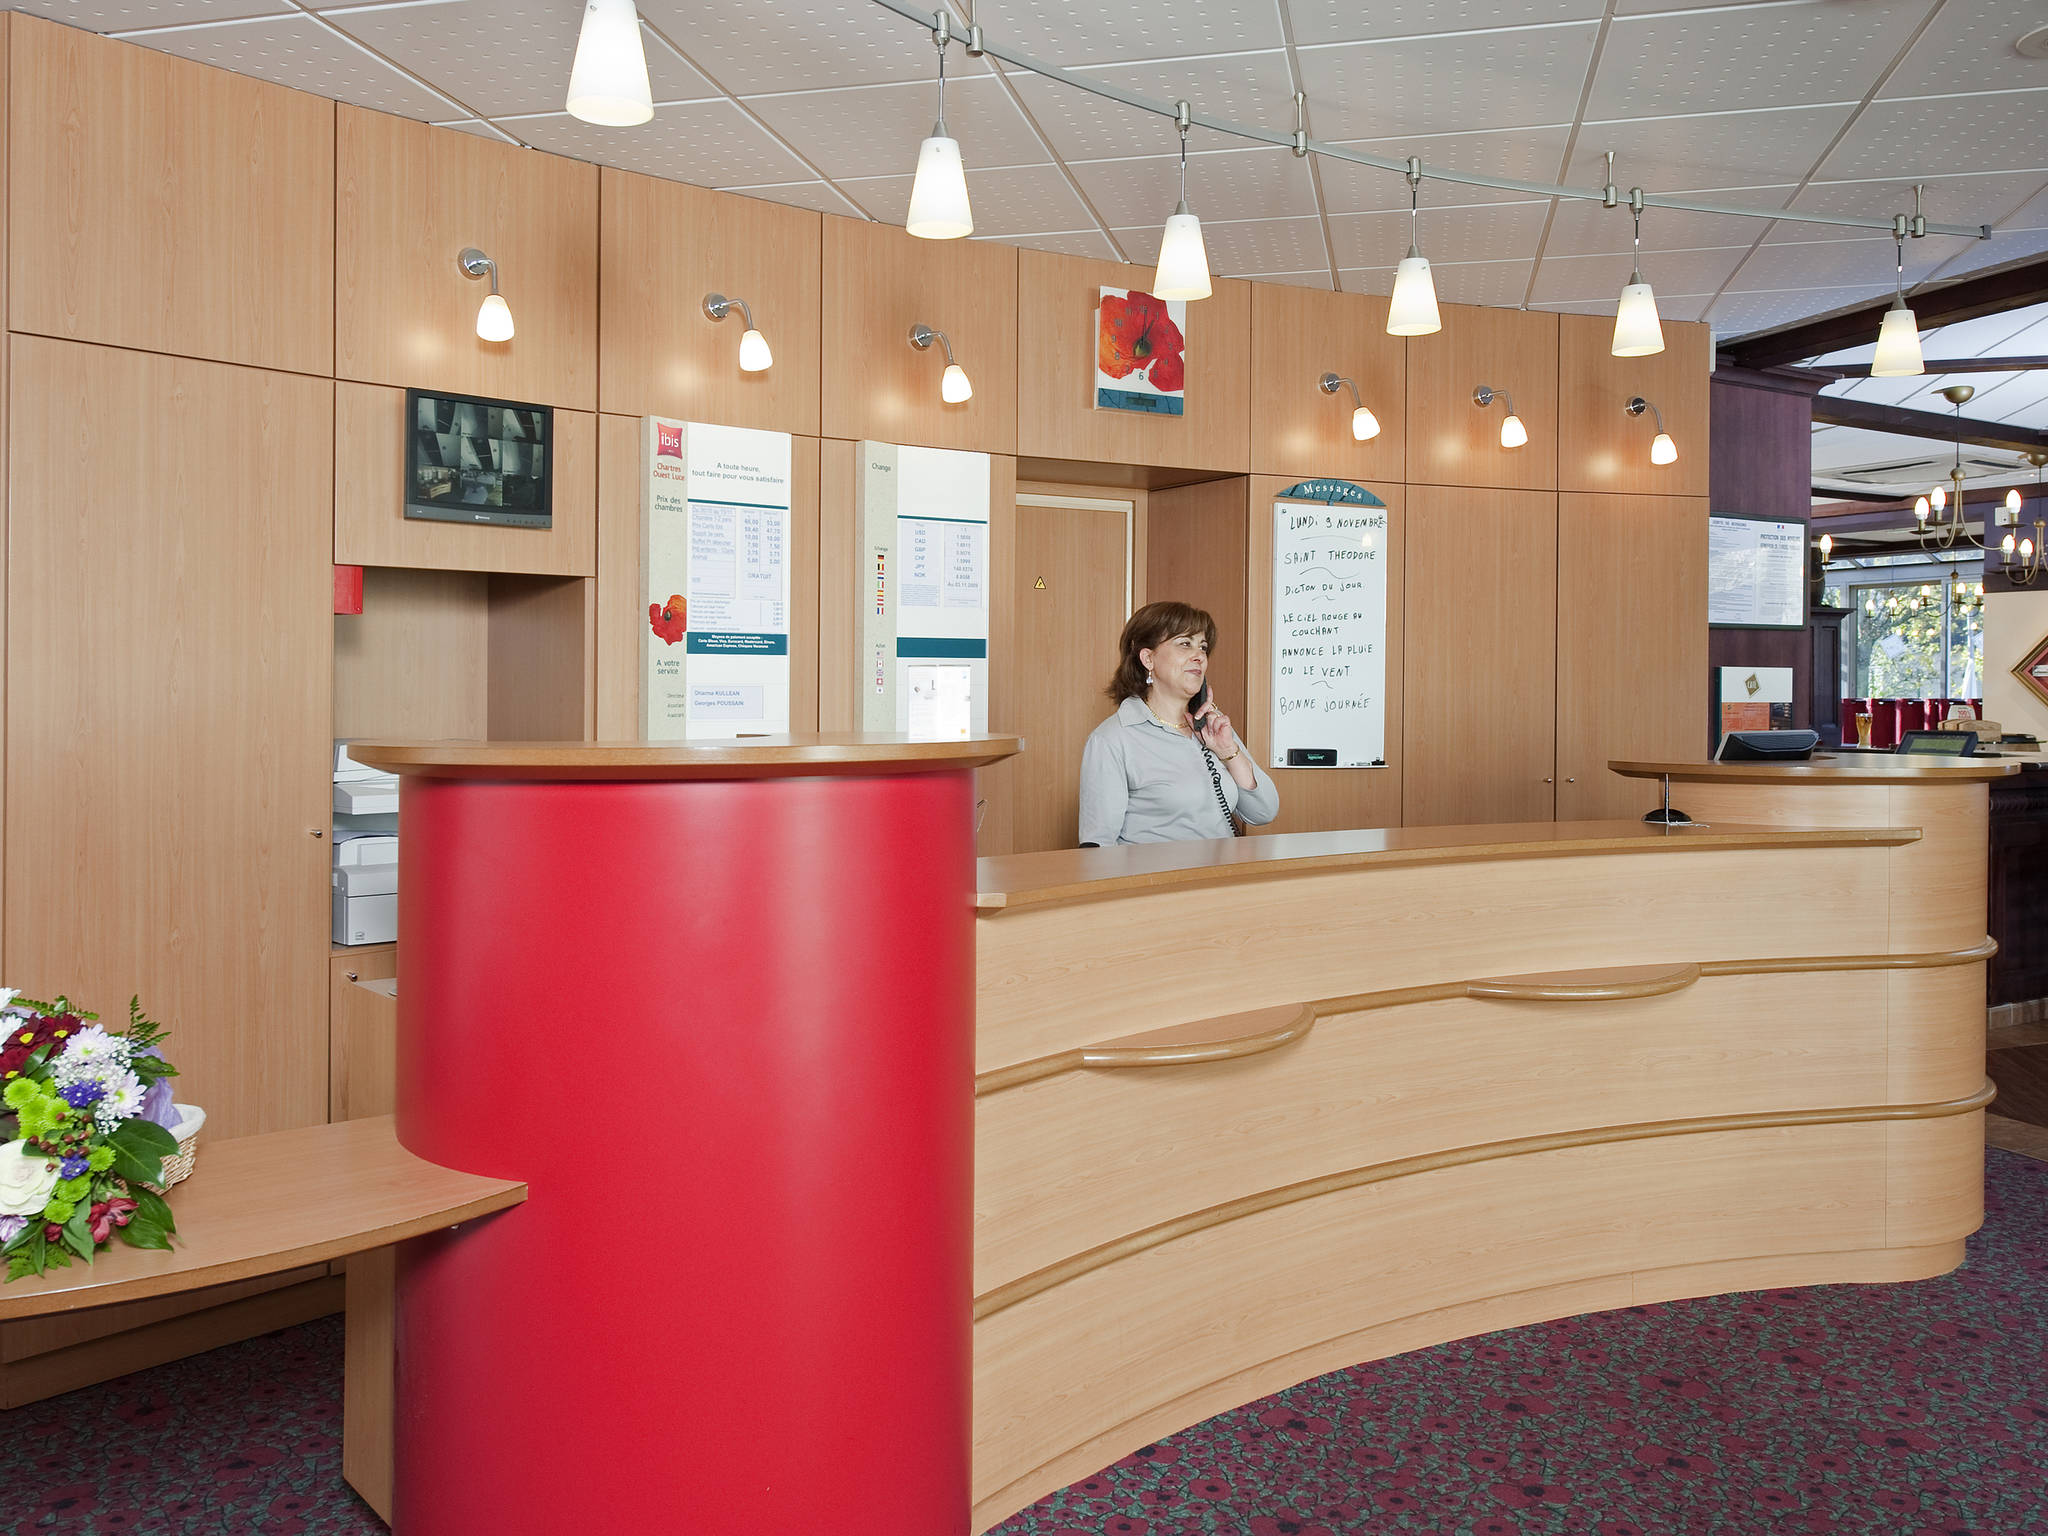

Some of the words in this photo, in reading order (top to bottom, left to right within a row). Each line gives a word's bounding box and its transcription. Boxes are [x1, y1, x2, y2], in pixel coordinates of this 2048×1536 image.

[1138, 371, 1144, 380] 6
[661, 432, 679, 448] ibis
[656, 462, 681, 472] Chartres
[723, 462, 740, 470] toute
[653, 470, 670, 480] Ouest
[706, 470, 721, 478] faire
[722, 474, 738, 482] pour
[756, 474, 784, 484] satisfaire
[1304, 483, 1362, 500] Messages
[656, 494, 668, 503] Prix
[670, 496, 680, 504] des
[654, 503, 682, 512] chambres
[1326, 517, 1332, 528] 9
[1336, 518, 1386, 529] NOVEMBRE
[1328, 550, 1376, 560] THEODORE
[1340, 582, 1362, 592] JOUR
[1283, 613, 1294, 623] LE
[1322, 612, 1348, 621] ROUGE
[1292, 626, 1339, 636] COUCHANT
[1282, 647, 1324, 658] ANNONCE
[1281, 666, 1293, 675] OU
[1304, 666, 1314, 675] LE
[1322, 666, 1350, 677] VENT
[1280, 696, 1316, 715] BONNE
